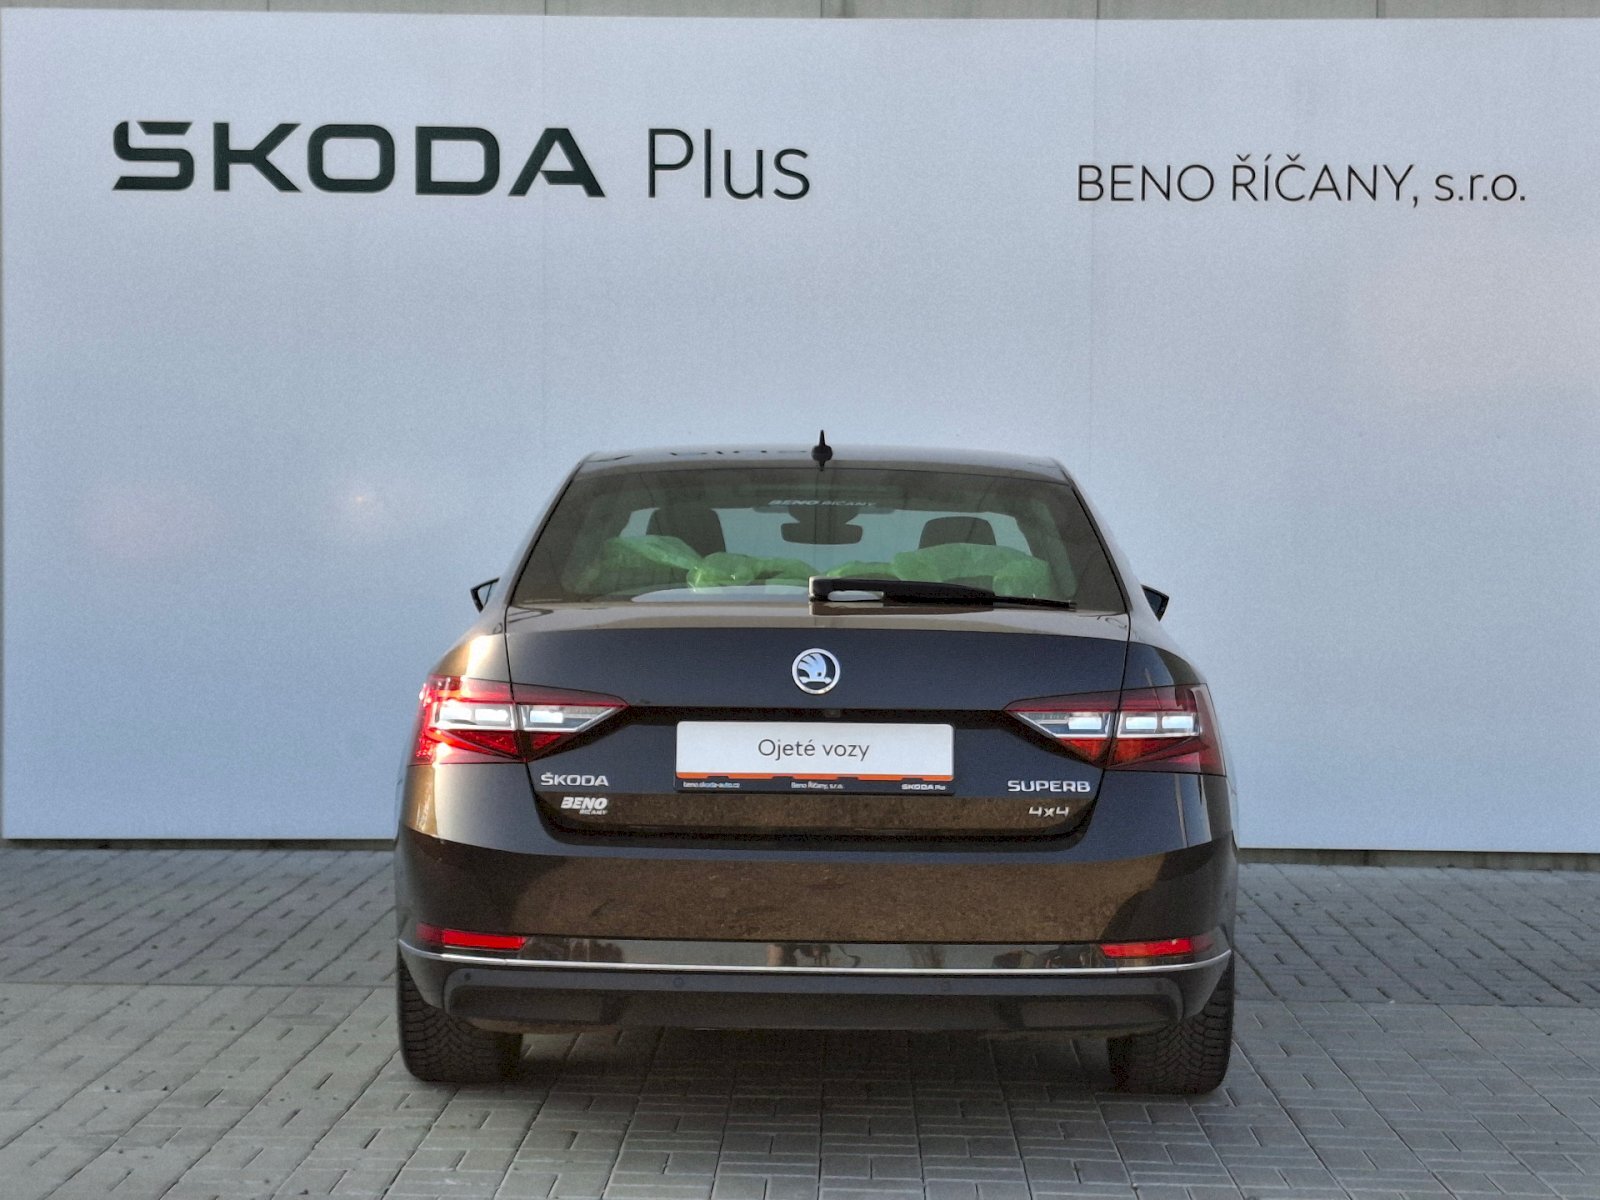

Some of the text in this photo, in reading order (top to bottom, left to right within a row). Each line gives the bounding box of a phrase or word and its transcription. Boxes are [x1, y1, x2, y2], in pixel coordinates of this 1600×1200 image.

[649, 128, 811, 201] Plus
[1078, 153, 1526, 208] BENO ŘÍČANY, s.r.o.
[758, 738, 870, 761] Ojeté vozy
[540, 771, 609, 787] ŠKODA
[1007, 780, 1091, 792] SUPERB
[561, 796, 608, 810] BENO
[1028, 806, 1070, 817] 4x4
